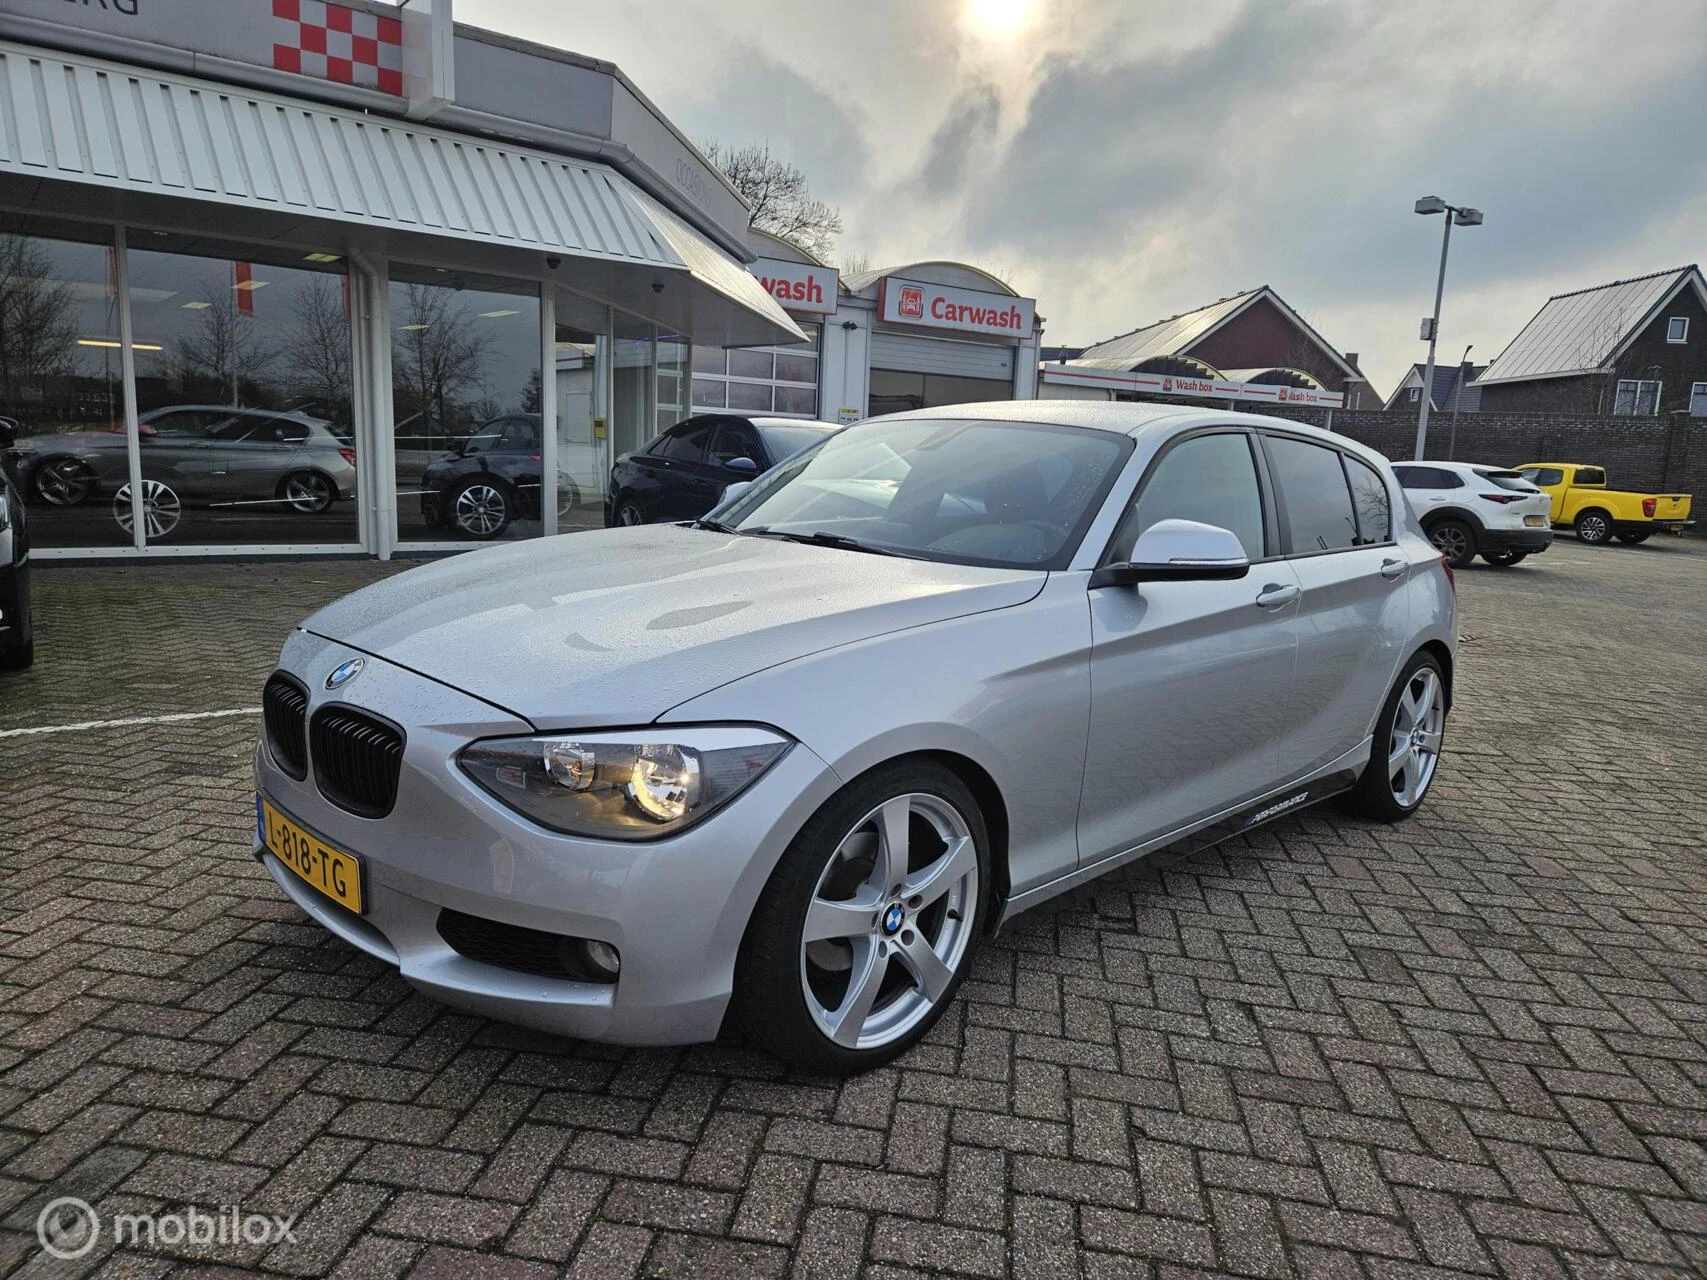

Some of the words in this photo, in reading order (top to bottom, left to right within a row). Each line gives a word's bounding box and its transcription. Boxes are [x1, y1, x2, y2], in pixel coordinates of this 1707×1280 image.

[931, 296, 1022, 330] Carwash
[1176, 379, 1198, 391] Wash
[1199, 380, 1213, 392] box
[268, 811, 347, 898] L-818-TG
